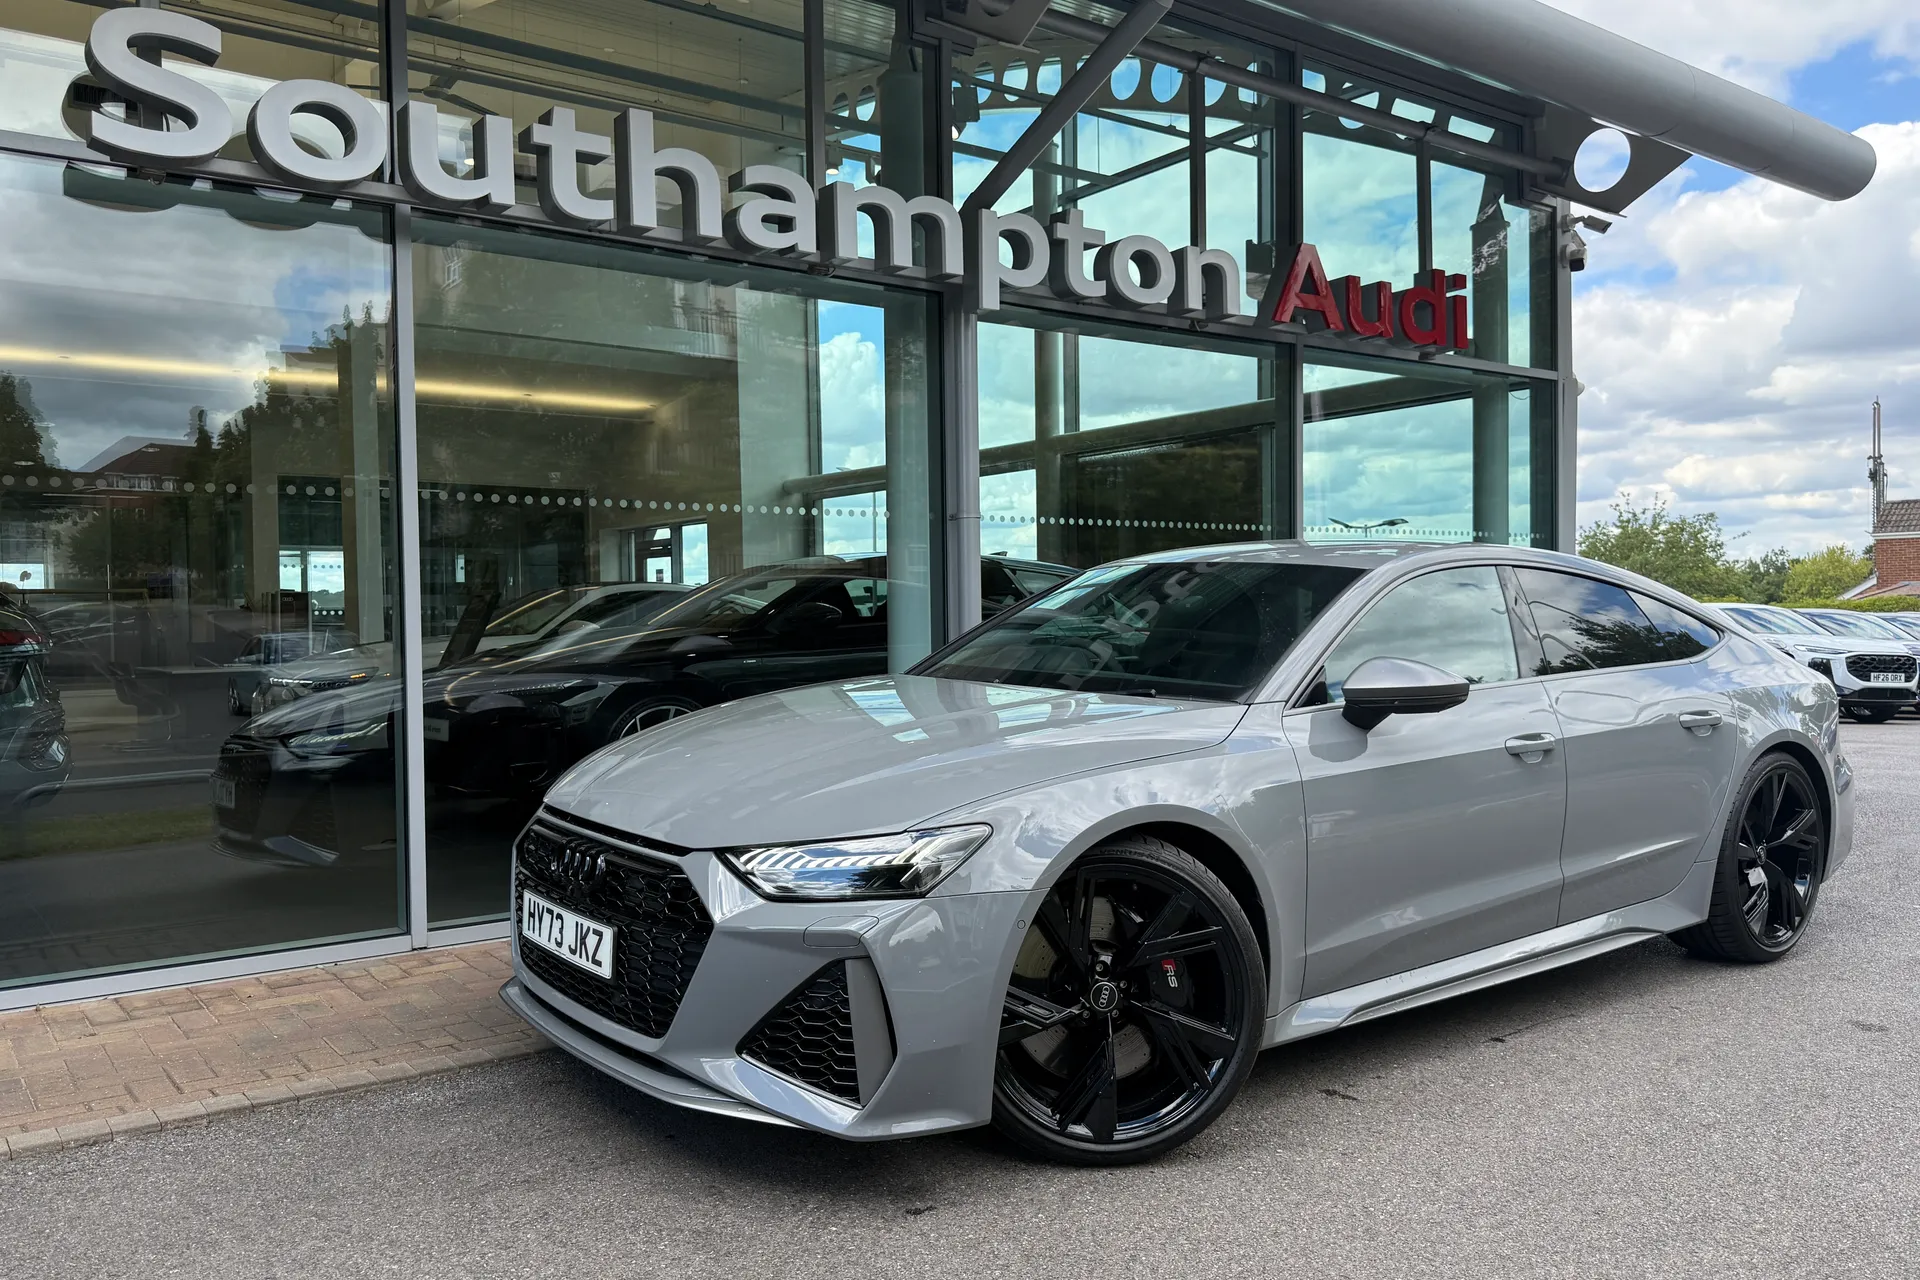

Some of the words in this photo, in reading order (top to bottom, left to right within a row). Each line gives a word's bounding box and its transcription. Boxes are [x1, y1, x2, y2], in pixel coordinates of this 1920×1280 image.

[86, 7, 1241, 310] Southampton
[1271, 243, 1469, 349] Audi
[1873, 673, 1890, 682] HF26
[527, 897, 565, 949] HY73
[568, 920, 604, 969] JKZ
[1164, 964, 1179, 988] RS
